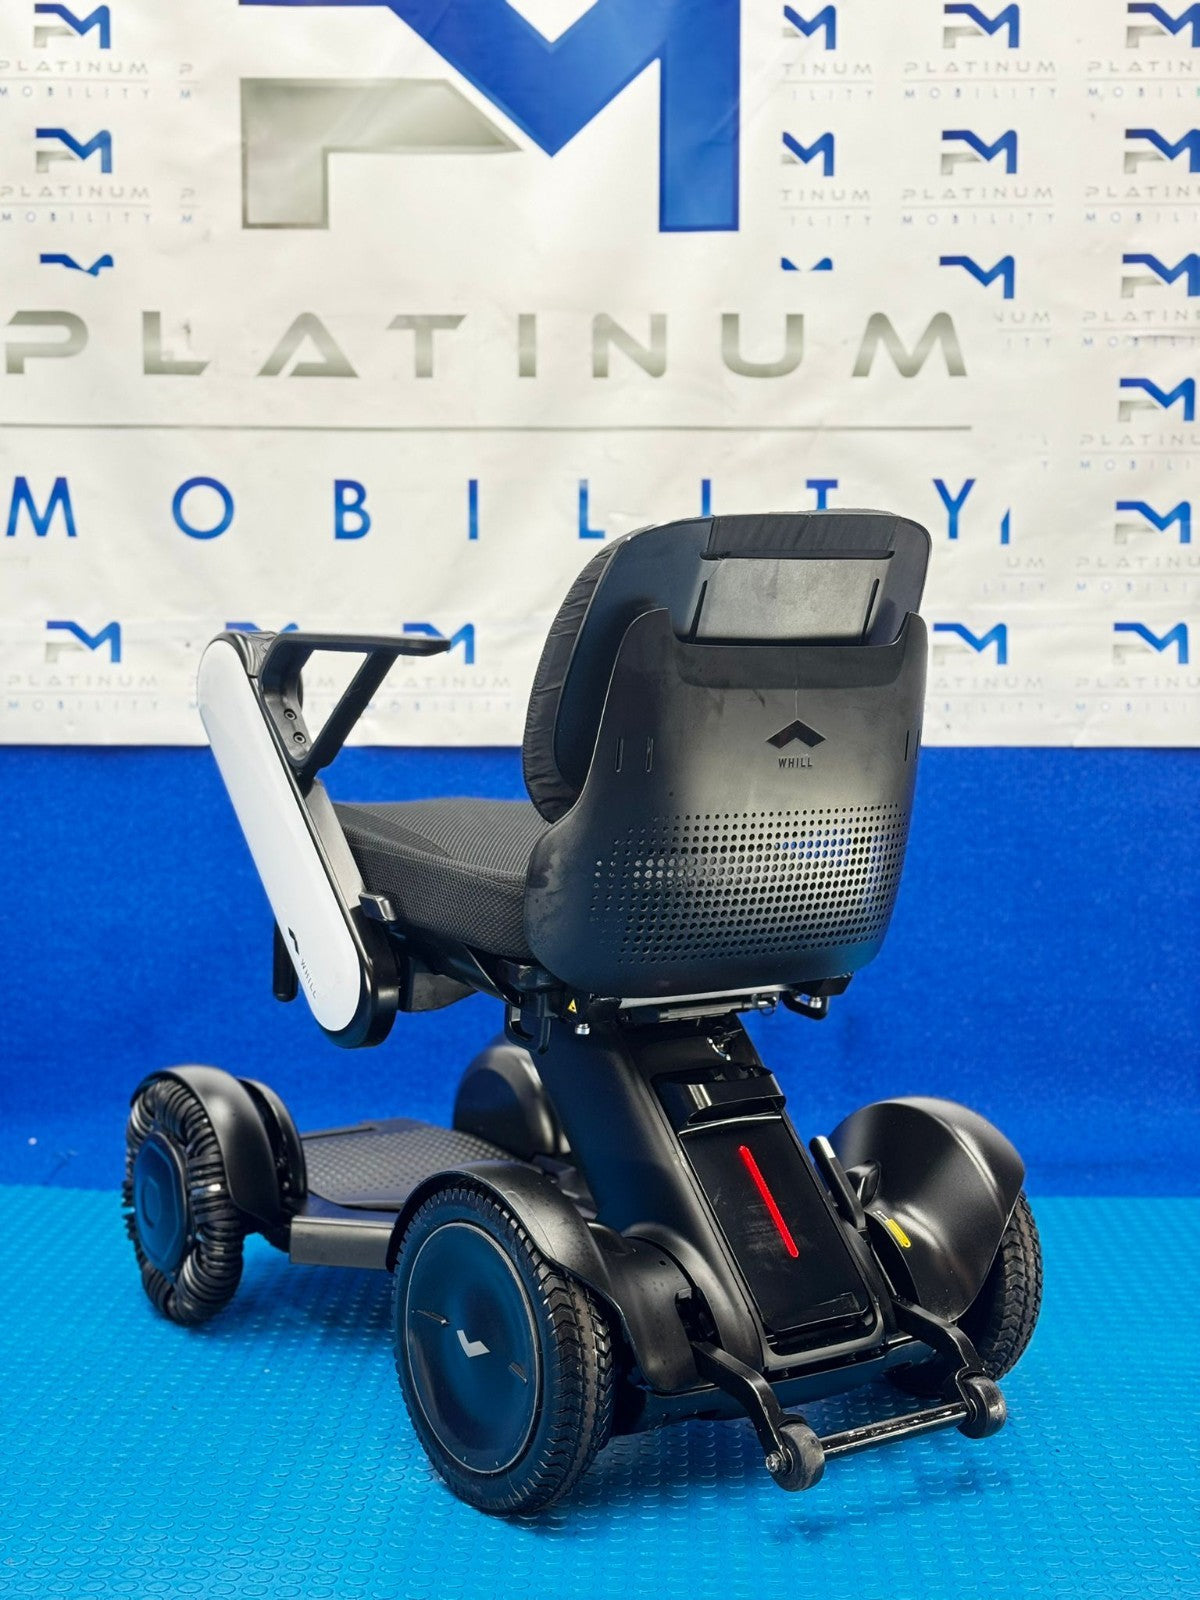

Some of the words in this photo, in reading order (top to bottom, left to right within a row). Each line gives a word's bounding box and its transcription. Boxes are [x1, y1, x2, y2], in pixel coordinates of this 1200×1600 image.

[0, 60, 148, 75] PLATINUM
[904, 61, 1056, 74] PLATINUM
[0, 185, 149, 199] PLATINUM
[902, 185, 1053, 199] PLATINUM
[1085, 185, 1200, 198] PLATIN
[6, 309, 968, 379] PLATINUM
[5, 475, 976, 541] MOBILITY
[778, 757, 813, 768] WHILL
